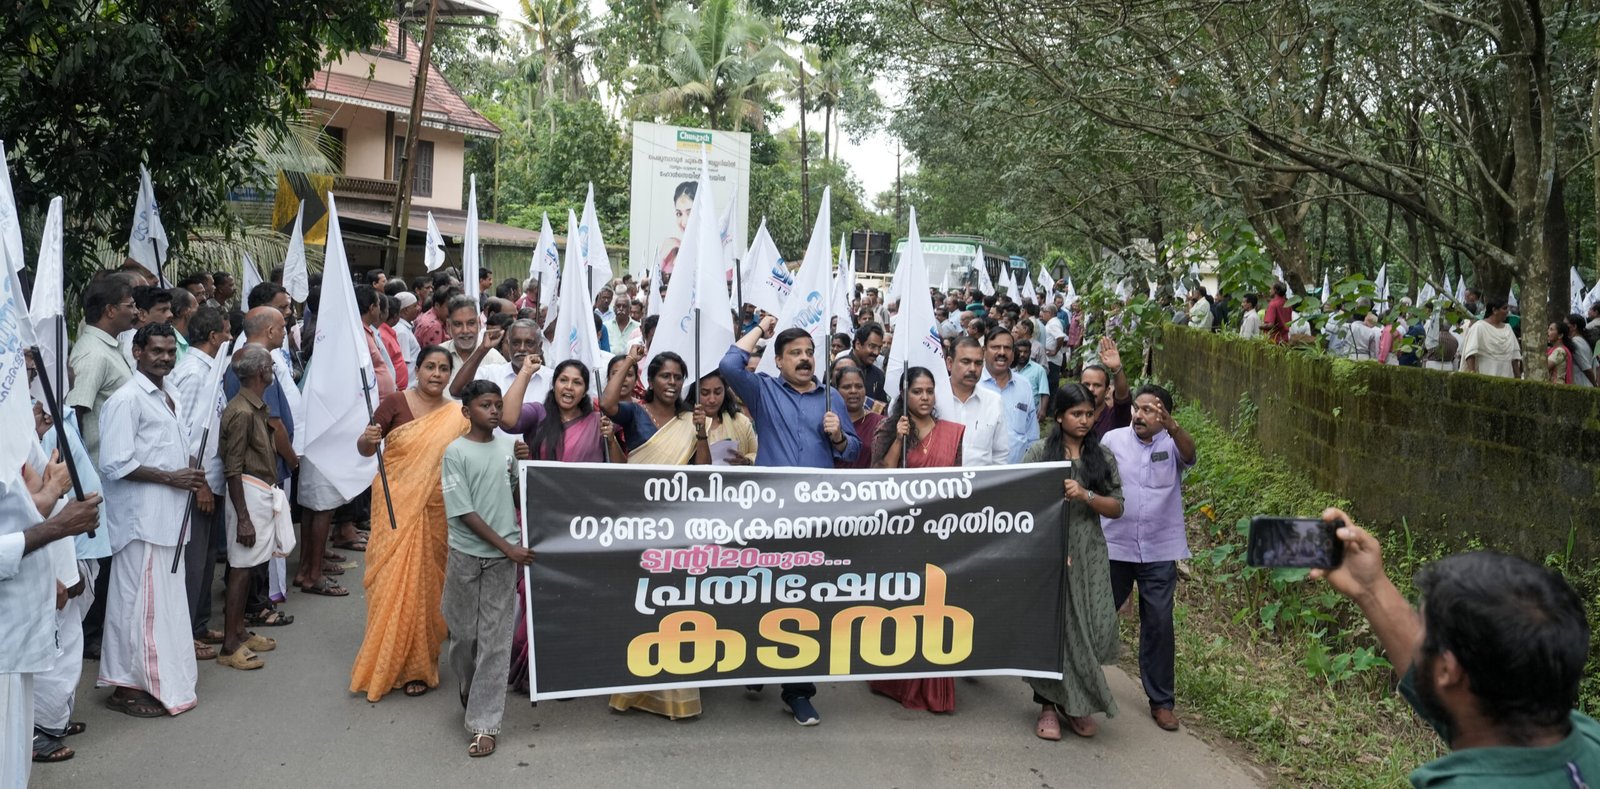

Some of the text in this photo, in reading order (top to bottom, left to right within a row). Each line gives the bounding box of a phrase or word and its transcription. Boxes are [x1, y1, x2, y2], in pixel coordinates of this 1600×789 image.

[643, 471, 974, 509] സിപിഎം, കോൺഗ്രസ്
[569, 505, 1034, 547] ഗുണ്ടാ ആക്രമണത്തിന് എതിരെ
[634, 567, 920, 615] പ്രതിഷേധ
[626, 563, 975, 677] കടൽ
